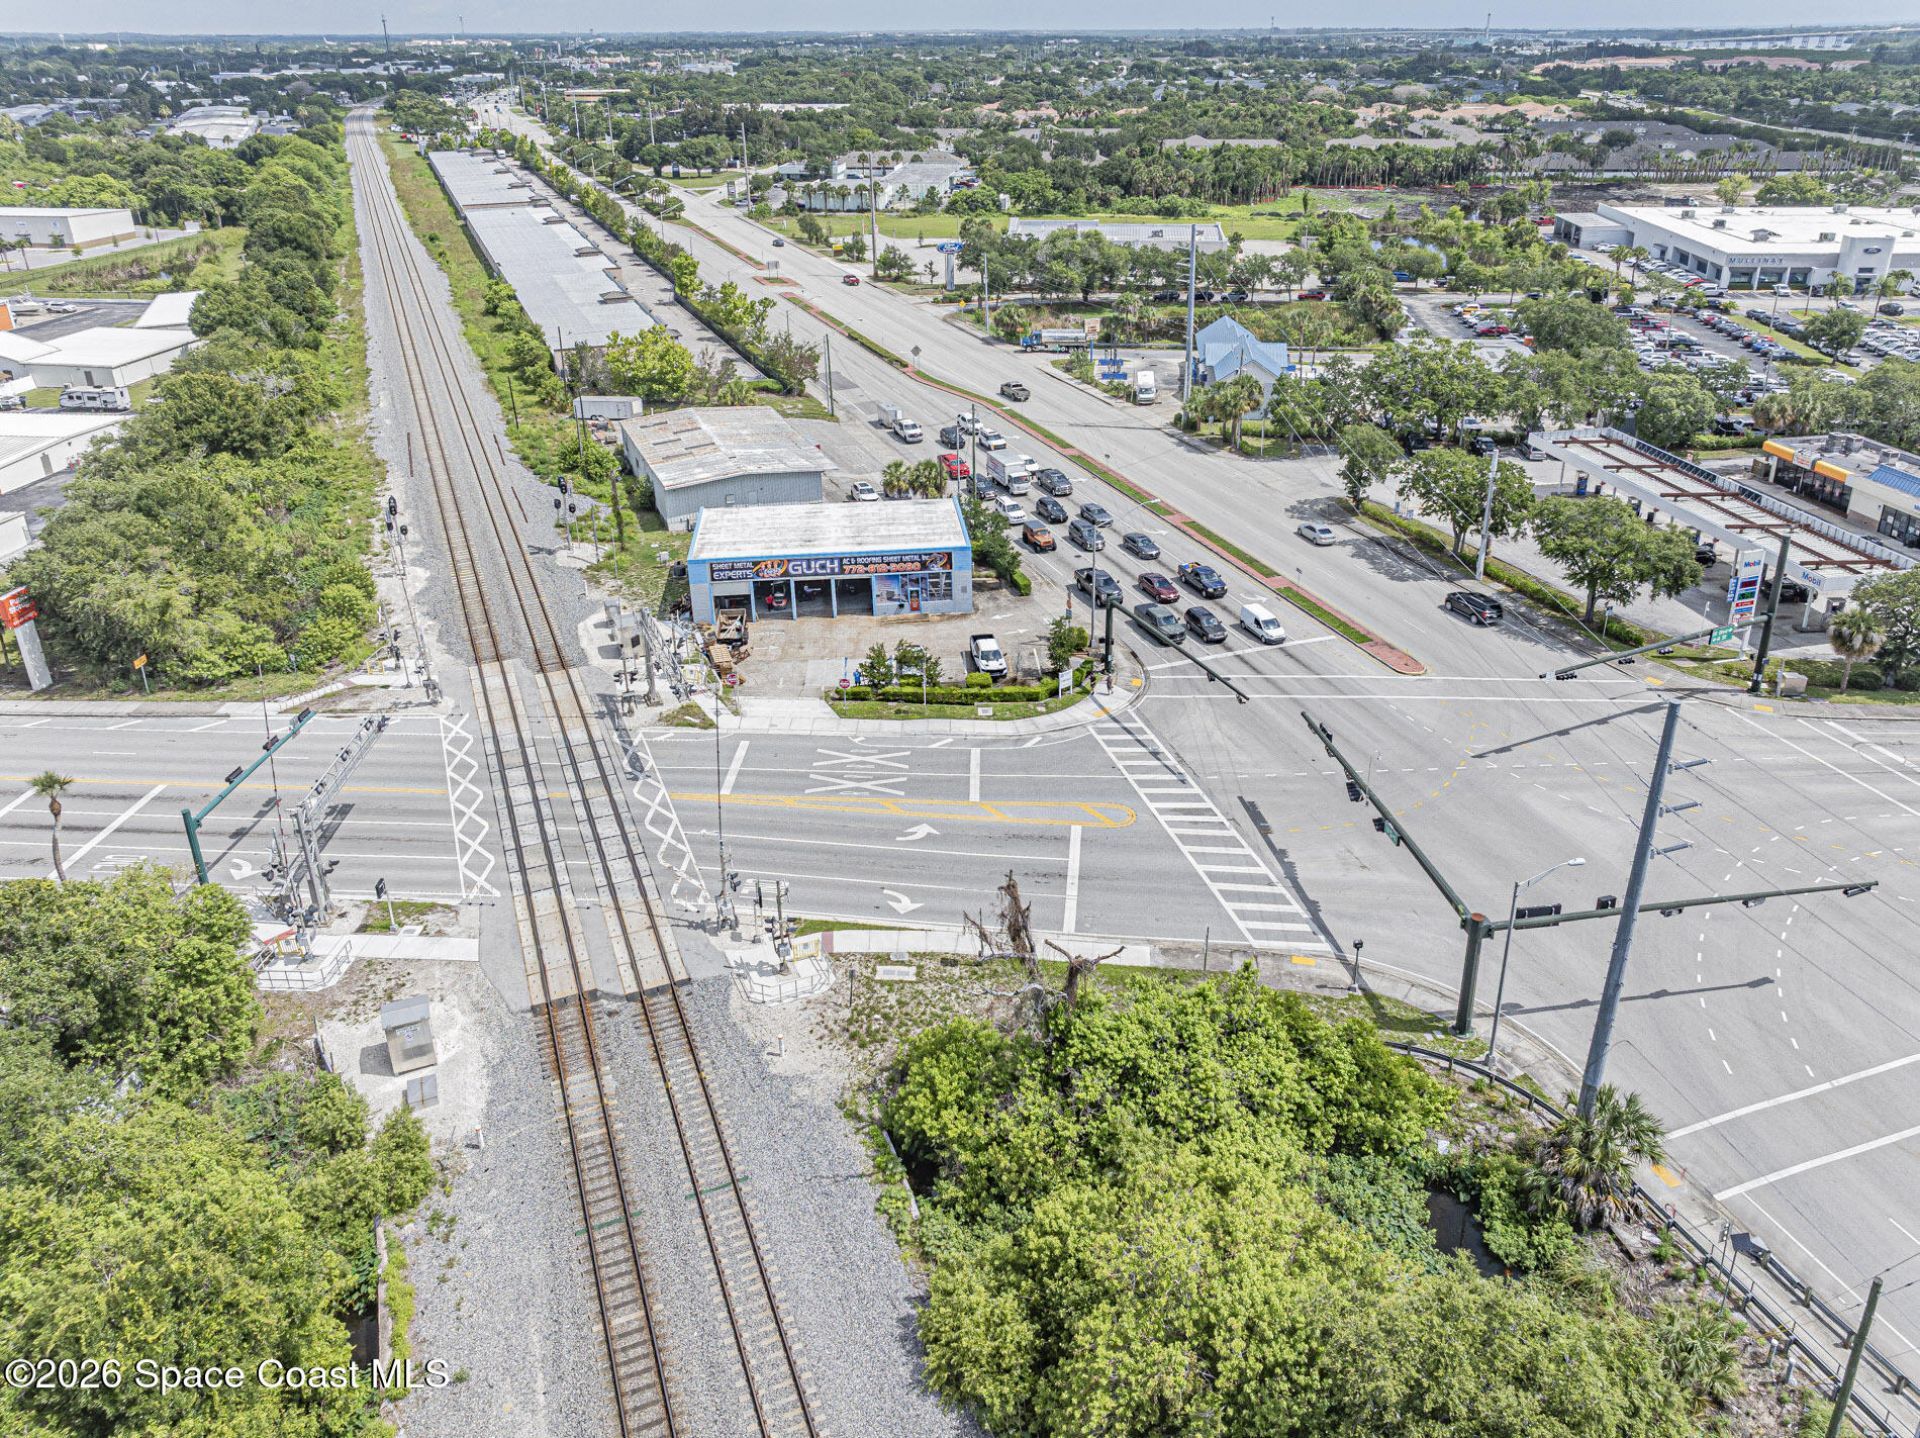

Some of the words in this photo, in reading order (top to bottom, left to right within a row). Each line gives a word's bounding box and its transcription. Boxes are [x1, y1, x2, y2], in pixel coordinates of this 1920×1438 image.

[842, 557, 851, 565] AC
[857, 556, 883, 565] ROOFING
[883, 555, 901, 563] SHEET
[902, 554, 921, 562] METAL
[1743, 559, 1762, 568] Mobil
[712, 563, 733, 571] SHEET
[734, 561, 755, 569] METAL
[788, 559, 840, 575] GUCH
[713, 570, 753, 580] EXPERTS
[1801, 571, 1822, 586] Mobil
